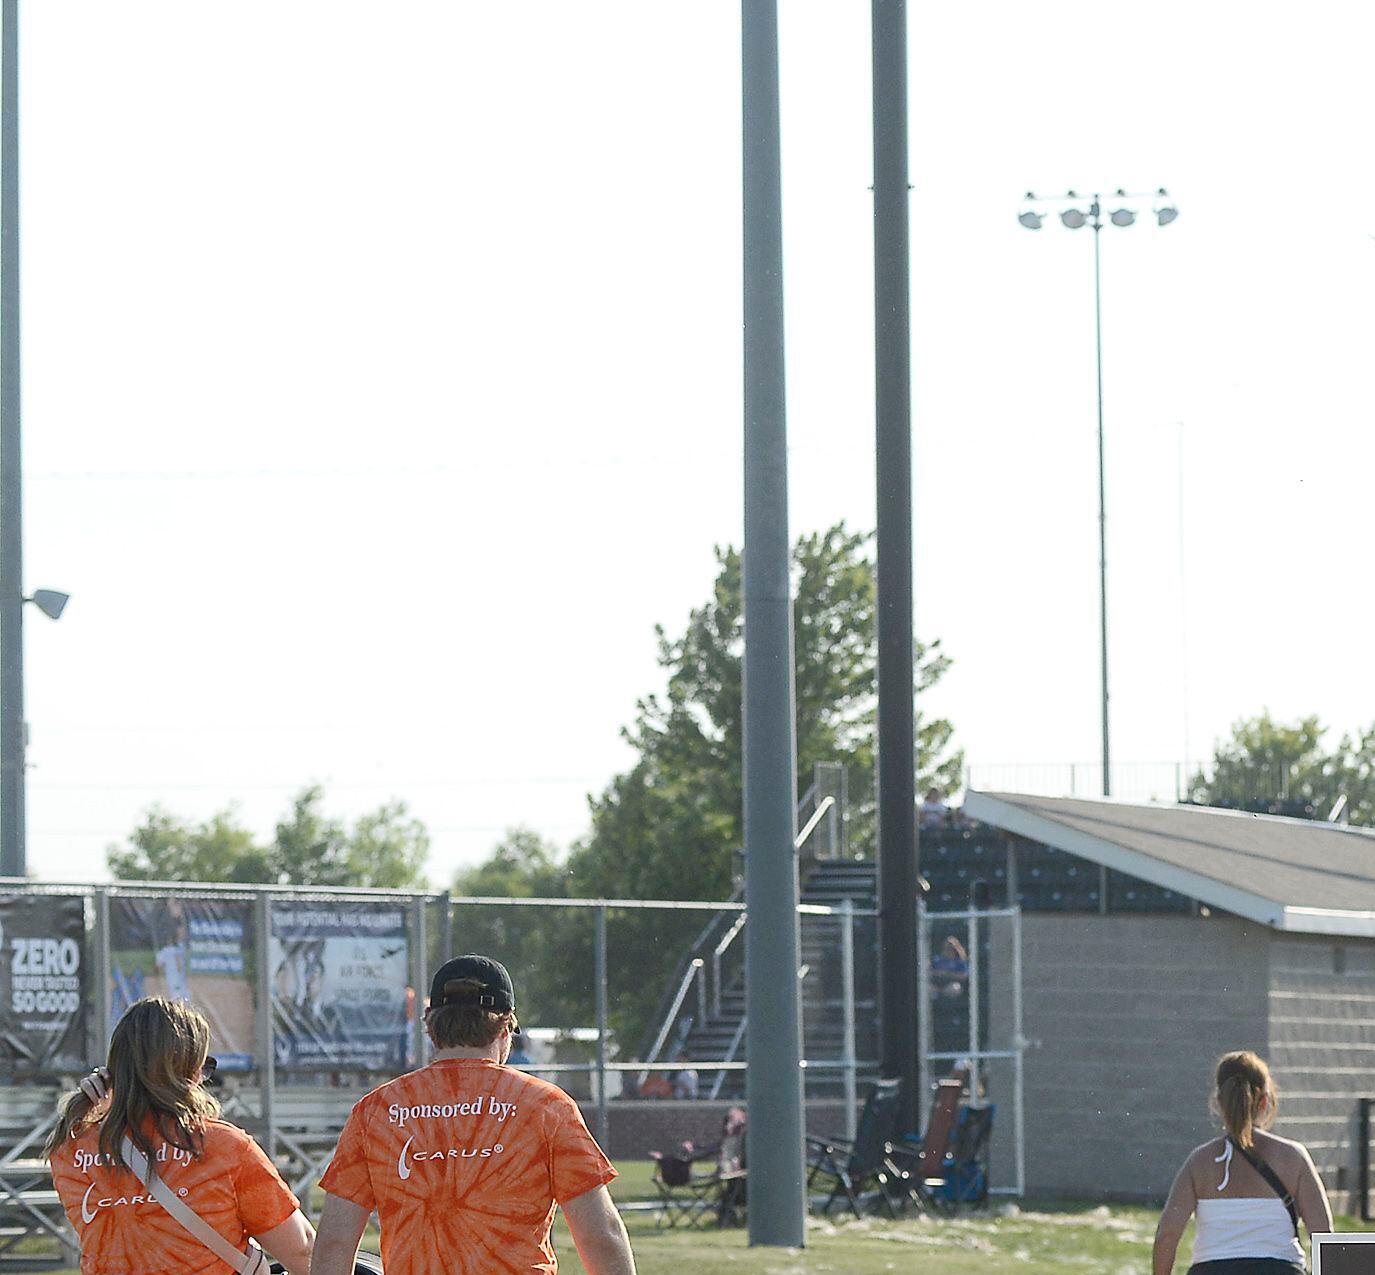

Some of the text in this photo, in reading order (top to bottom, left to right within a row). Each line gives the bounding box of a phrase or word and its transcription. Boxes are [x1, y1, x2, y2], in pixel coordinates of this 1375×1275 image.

[11, 937, 80, 975] ZERO
[12, 990, 80, 1013] SO GOOD
[388, 1096, 517, 1128] Sponsored by:
